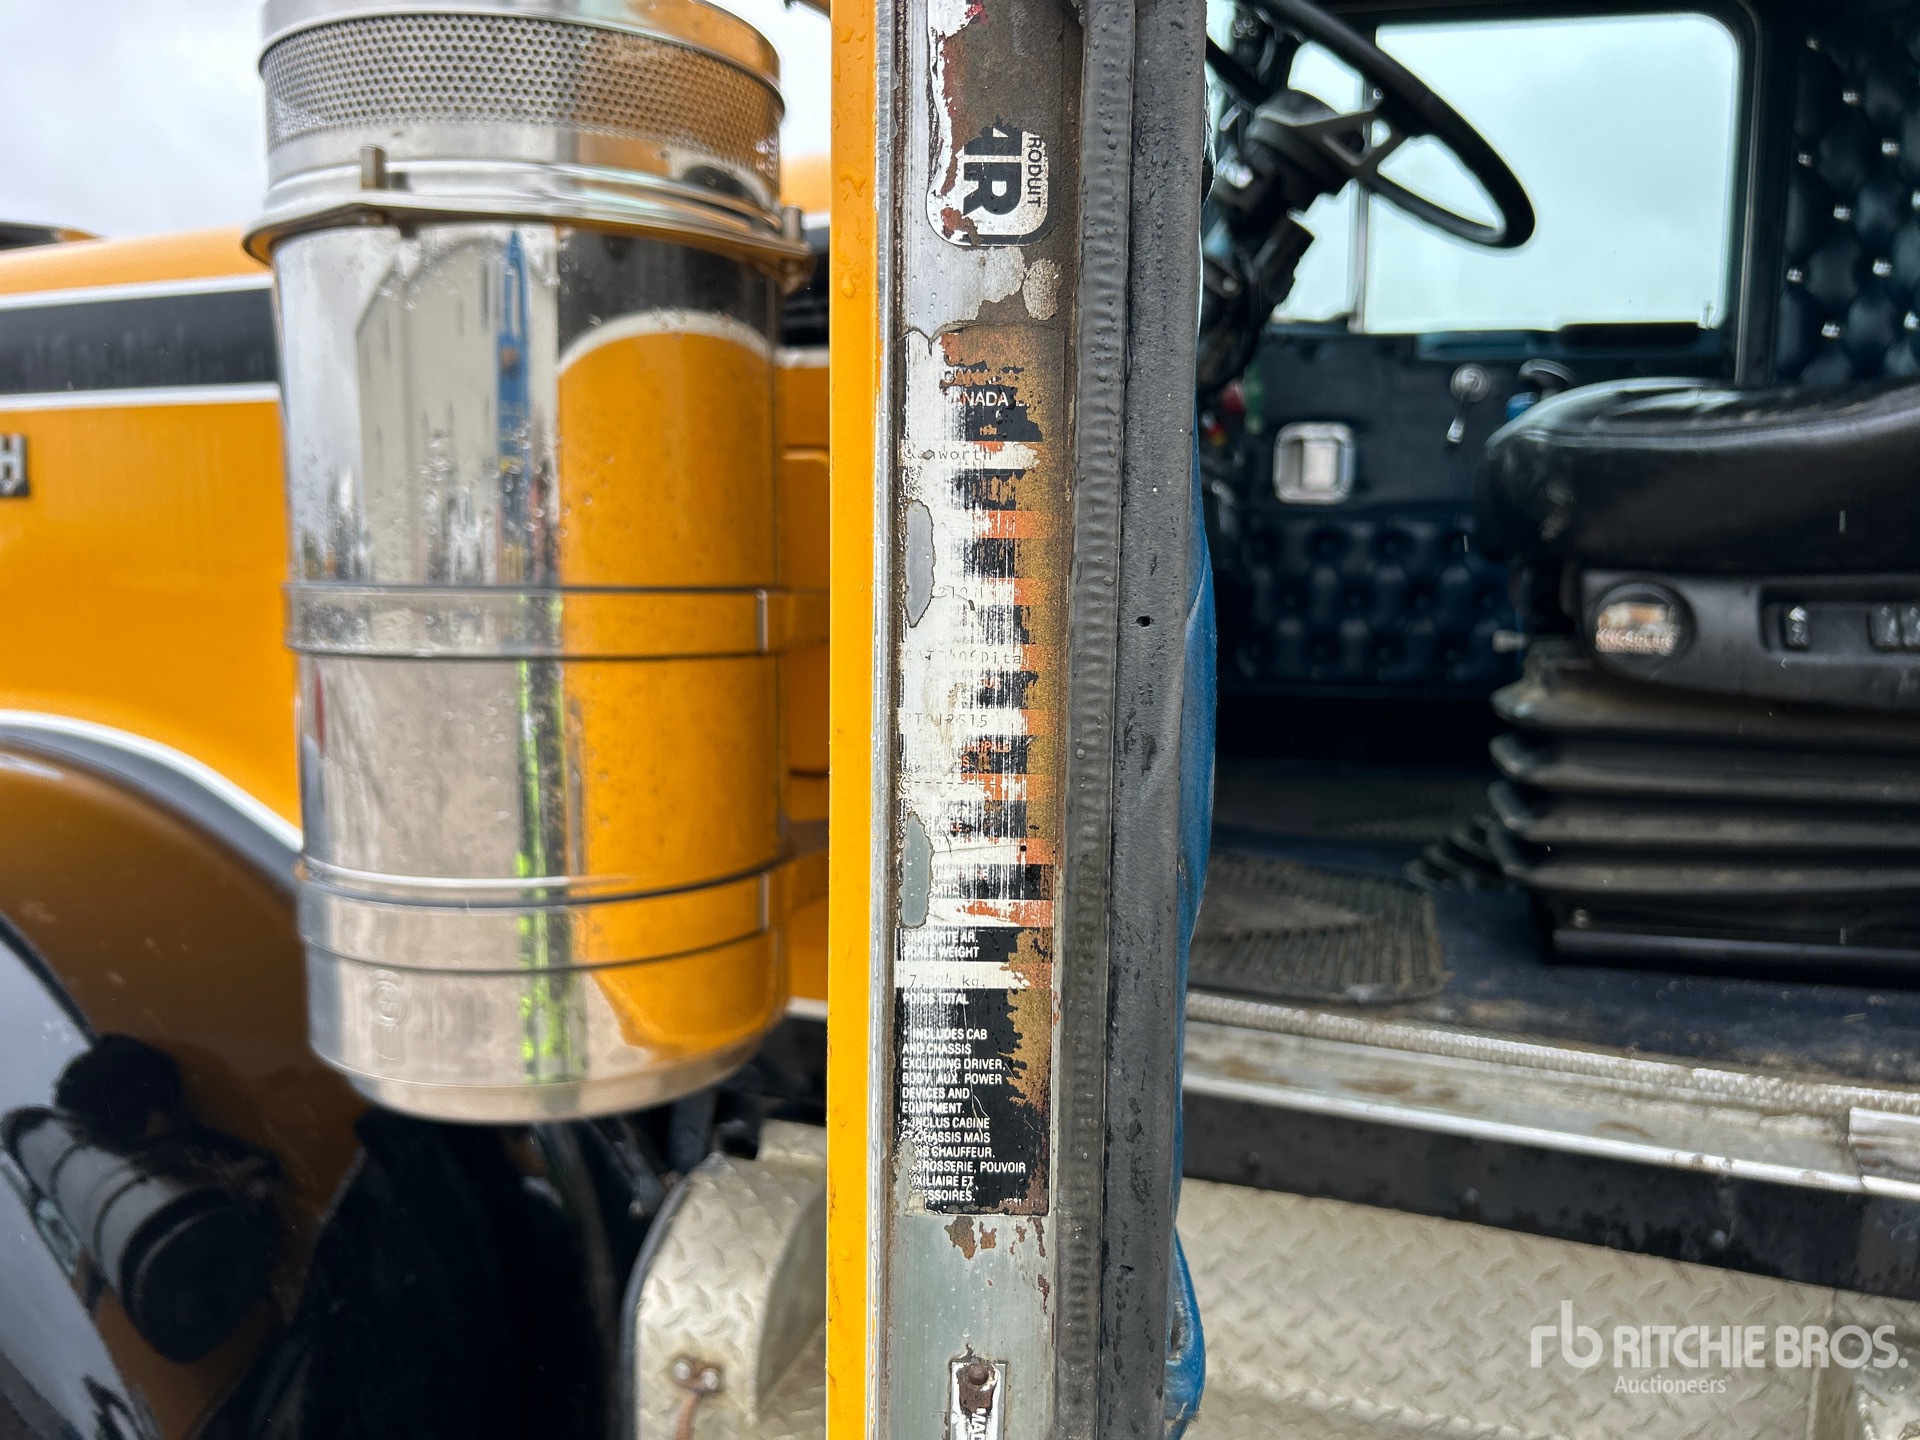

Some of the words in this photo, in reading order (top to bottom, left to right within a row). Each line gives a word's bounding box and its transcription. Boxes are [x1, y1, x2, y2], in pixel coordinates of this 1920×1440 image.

[1027, 135, 1042, 208] RODUIT
[960, 931, 979, 943] AR.
[938, 946, 980, 959] WEIGHT
[936, 993, 970, 1005] TOTAL
[912, 1028, 964, 1040] INCLUDES
[966, 1029, 988, 1040] CAB
[902, 1043, 926, 1055] AND
[926, 1043, 972, 1055] CHASSIS
[902, 1058, 962, 1070] EXCLUDING
[963, 1059, 1006, 1071] DRIVER,
[937, 1073, 962, 1085] AUX.
[964, 1073, 1003, 1085] POWER
[902, 1087, 946, 1099] DEVICES
[947, 1088, 970, 1099] AND
[902, 1102, 965, 1114] EQUIPMENT.
[963, 1132, 991, 1143] MAIS
[979, 1161, 1026, 1173] POUVOIR
[961, 1175, 975, 1187] ET
